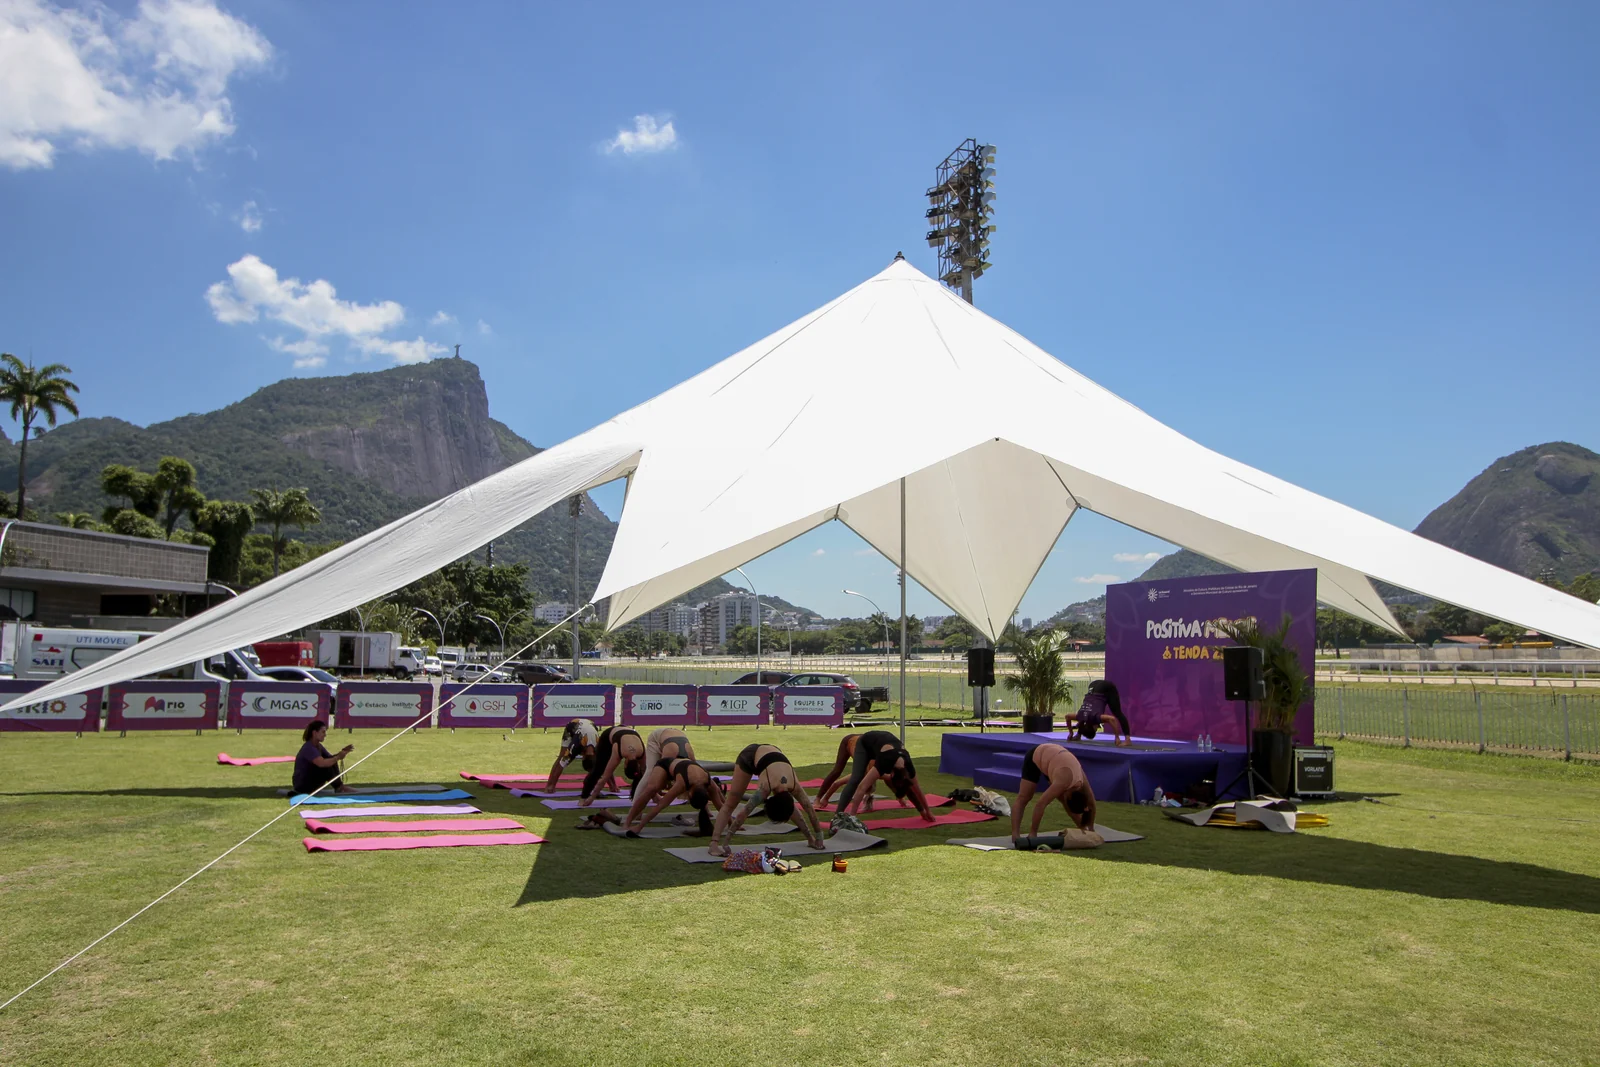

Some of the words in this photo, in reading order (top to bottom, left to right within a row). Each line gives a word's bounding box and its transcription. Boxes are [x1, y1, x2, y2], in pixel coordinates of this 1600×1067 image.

[76, 636, 92, 644] UTI
[94, 635, 129, 645] MÓVEL
[1173, 645, 1209, 660] TENDA
[482, 700, 506, 711] GSH
[647, 702, 663, 711] RIO
[730, 700, 748, 709] IGP
